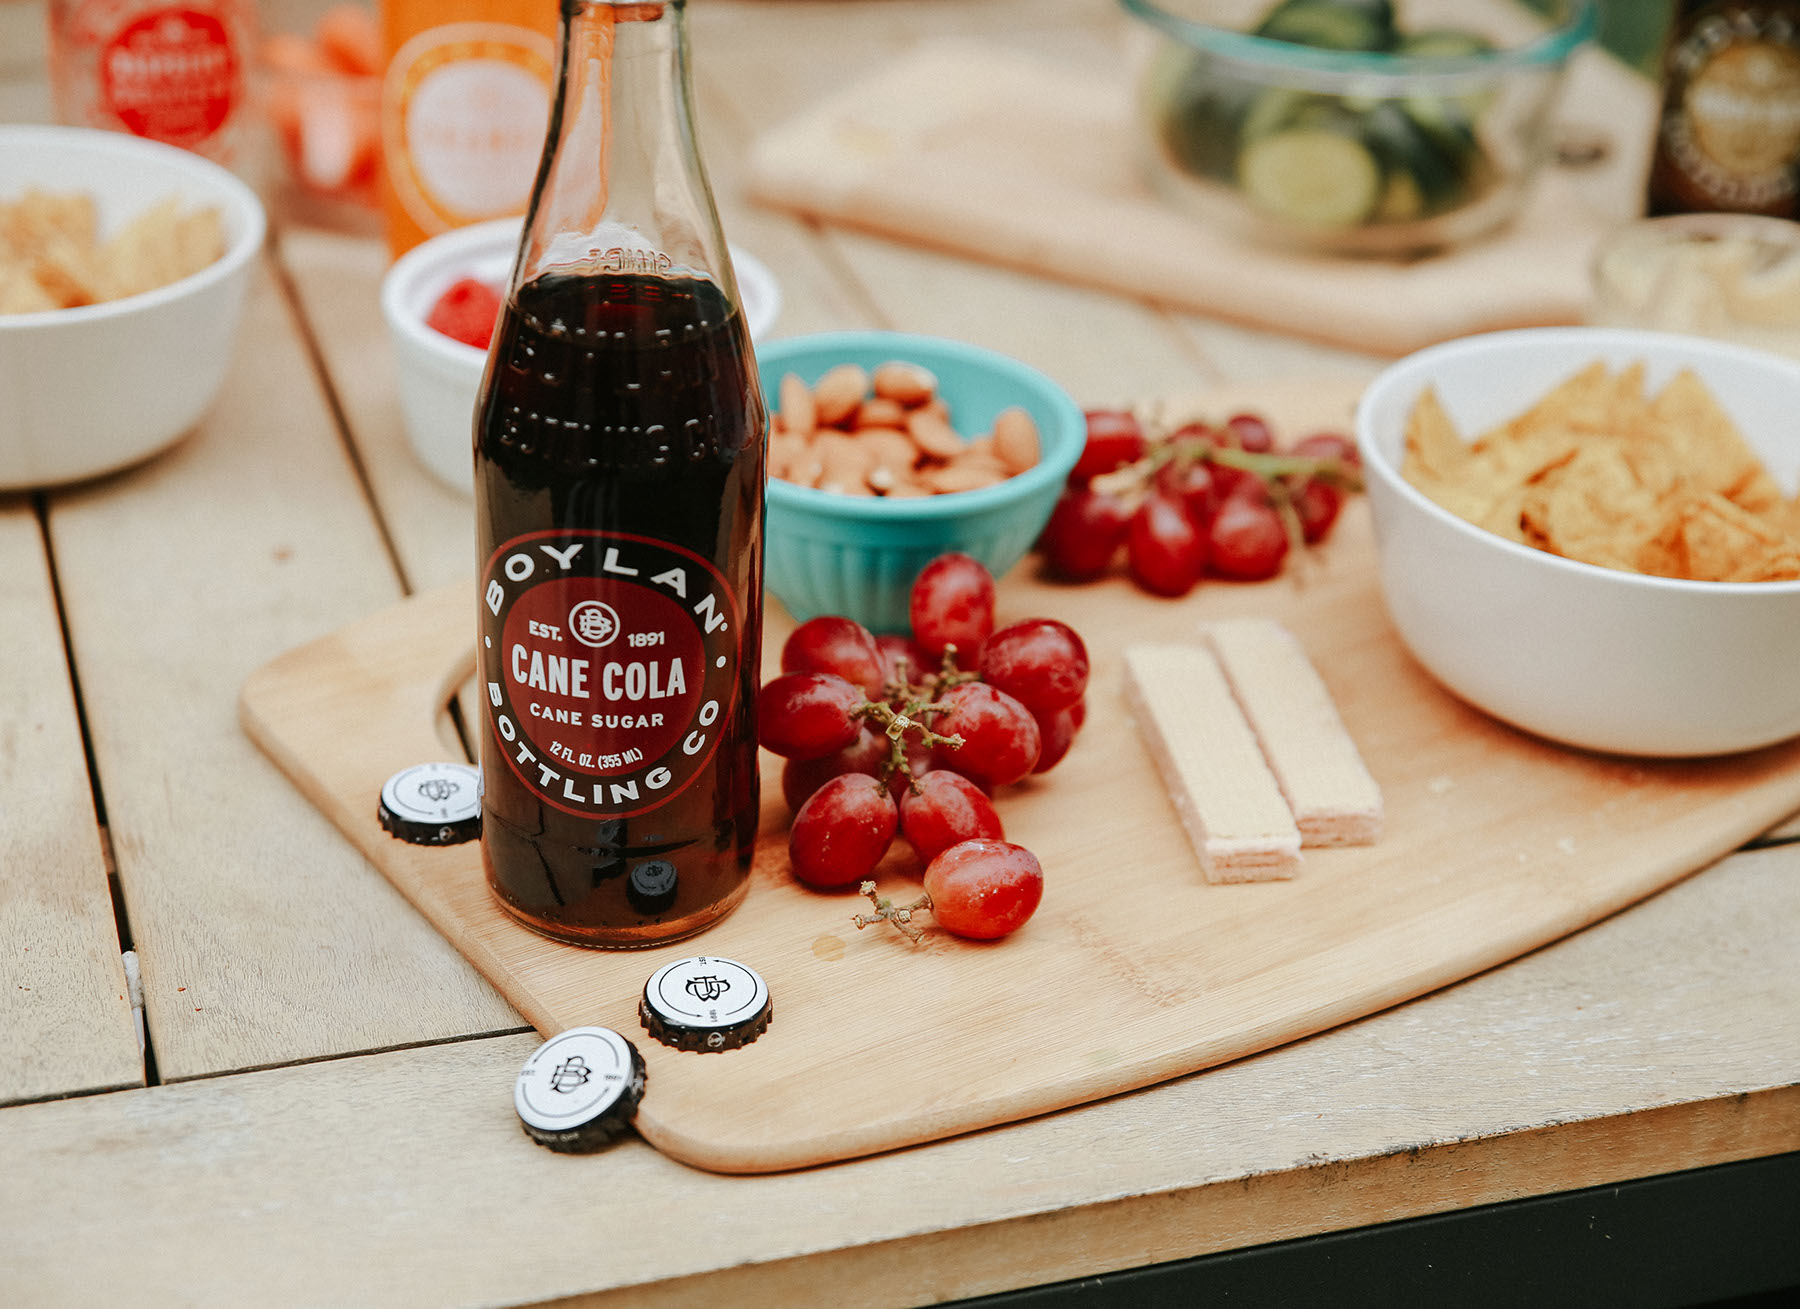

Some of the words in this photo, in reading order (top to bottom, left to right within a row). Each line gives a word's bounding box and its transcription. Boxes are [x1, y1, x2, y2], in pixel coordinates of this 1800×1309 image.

[528, 619, 563, 642] EST.
[627, 631, 665, 648] 1891
[511, 643, 590, 699] CANE
[602, 657, 687, 701] COLA
[529, 702, 583, 726] CANE
[591, 713, 664, 729] SUGAR
[487, 681, 672, 805] BOTTLING
[682, 700, 719, 756] CO
[549, 740, 563, 756] 12
[560, 746, 576, 764] FL.
[578, 753, 596, 769] OZ.
[597, 753, 622, 770] (355
[621, 747, 643, 765] ML)
